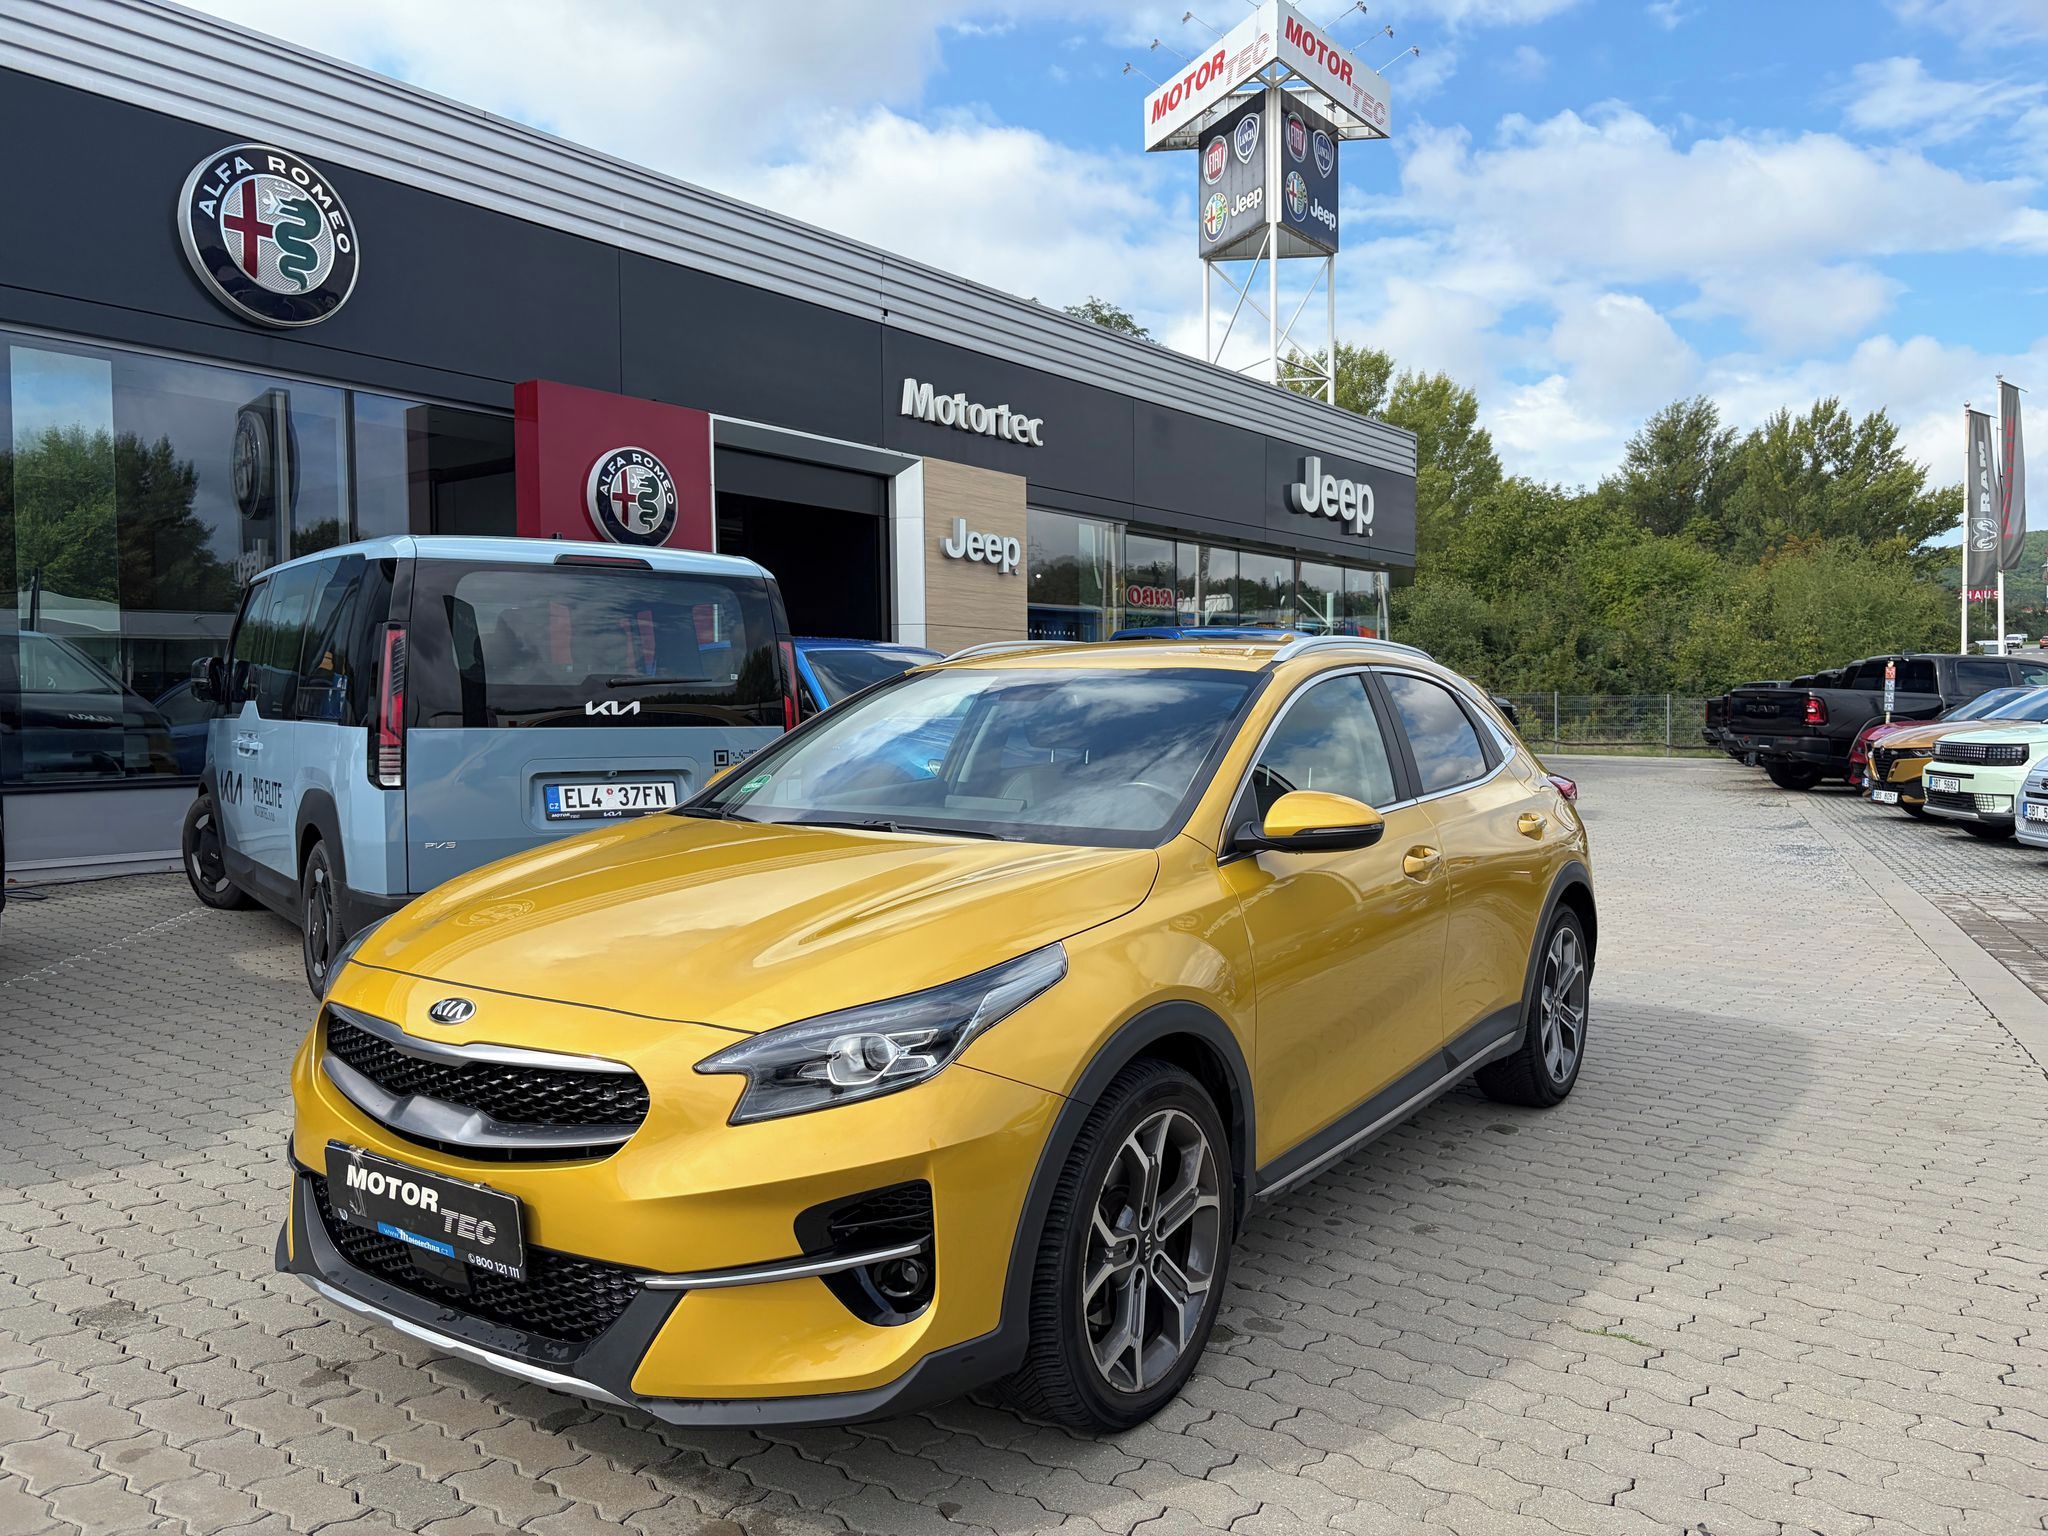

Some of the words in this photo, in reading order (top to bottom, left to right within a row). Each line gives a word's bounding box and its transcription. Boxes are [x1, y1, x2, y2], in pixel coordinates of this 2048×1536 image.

[1151, 49, 1226, 124] MOTOR
[1225, 33, 1269, 85] TEC
[1285, 16, 1353, 86] MOTOR
[1351, 84, 1386, 126] TEC
[1291, 123, 1303, 152] FIAT
[1208, 146, 1223, 175] FIAT
[198, 156, 254, 219] ALFA
[267, 155, 351, 254] ROMEO
[1231, 187, 1263, 216] Jeep
[1310, 198, 1336, 231] Jeep
[902, 377, 1044, 448] Motortec
[600, 456, 626, 496] ALFA
[632, 453, 674, 505] ROMEO
[1978, 441, 1991, 513] RAM
[1291, 456, 1375, 534] Jeep
[940, 518, 1021, 574] Jeep
[1958, 590, 1999, 600] HAUS
[585, 701, 641, 716] KIA
[221, 769, 243, 807] KIA
[264, 780, 283, 809] ELITE
[564, 787, 603, 809] EL4
[618, 786, 667, 807] 37FN
[549, 802, 560, 810] CZ
[2028, 805, 2039, 817] 3BT
[432, 1000, 467, 1019] KIA
[346, 1164, 439, 1213] MOTOR
[441, 1208, 497, 1245] TEC
[476, 1255, 493, 1270] 800
[494, 1262, 507, 1275] 121
[509, 1266, 520, 1279] 111
